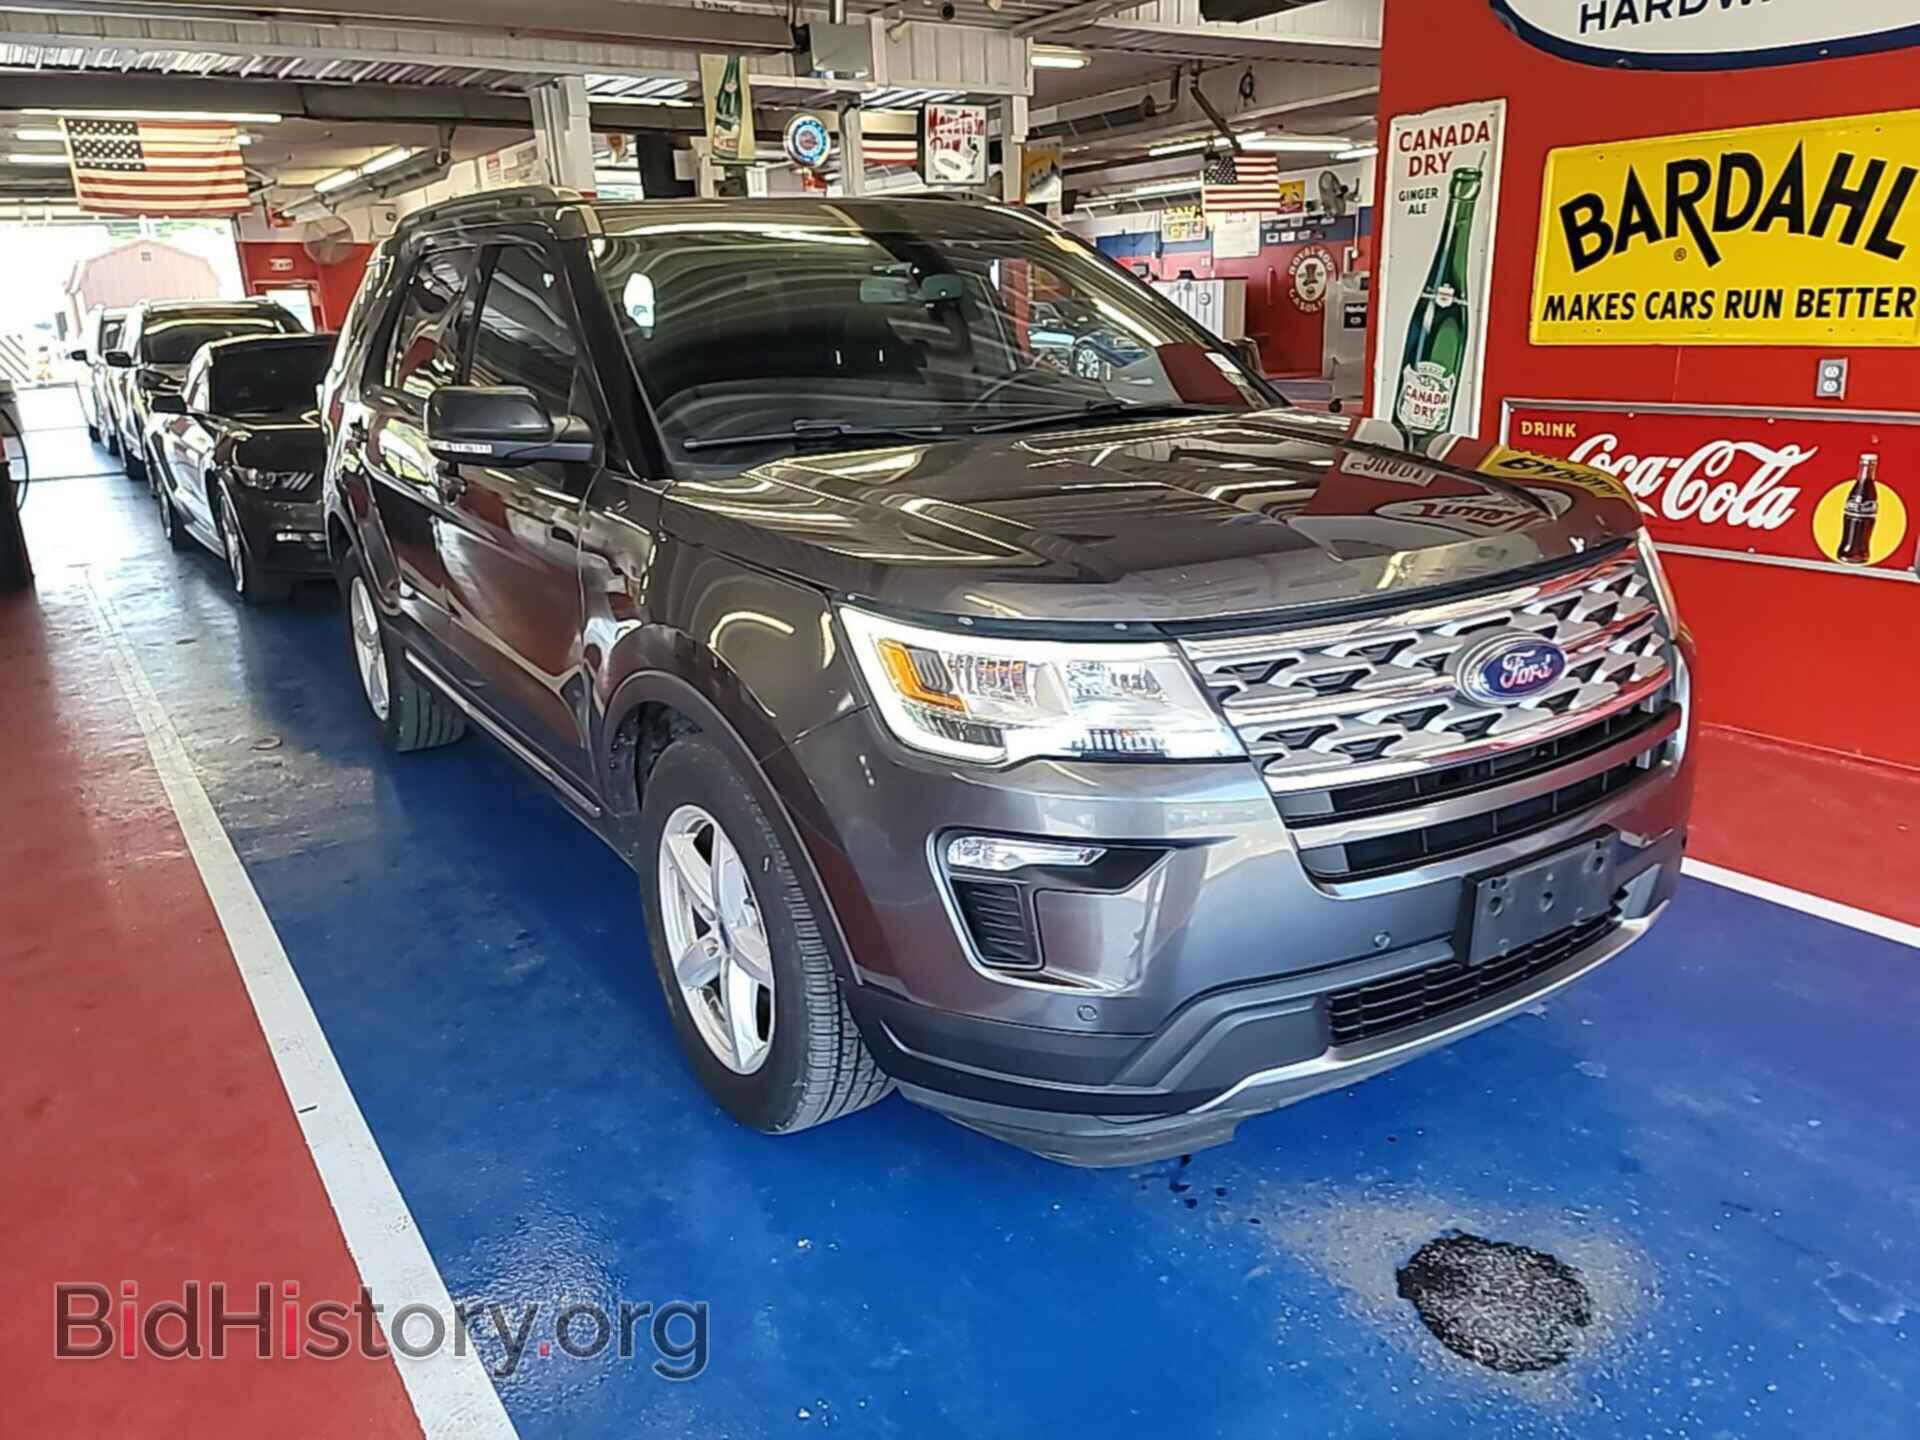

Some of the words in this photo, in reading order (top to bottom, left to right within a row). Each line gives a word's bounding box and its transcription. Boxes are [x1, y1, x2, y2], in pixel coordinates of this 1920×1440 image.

[1399, 120, 1491, 152] CANADA
[1408, 151, 1453, 177] DRY
[1398, 187, 1439, 202] GINGER
[1559, 139, 1918, 273] BARDAHL
[1408, 203, 1427, 215] ALE
[1543, 291, 1637, 322] MAKES
[1645, 291, 1715, 321] CARS
[1723, 288, 1784, 320] RUN
[1795, 286, 1917, 319] BETTER
[1406, 384, 1449, 405] CANADA
[1413, 404, 1437, 419] DRY
[1521, 421, 1577, 438] DRINK
[1567, 433, 1819, 530] Coca-Cola
[1500, 649, 1553, 689] Ford
